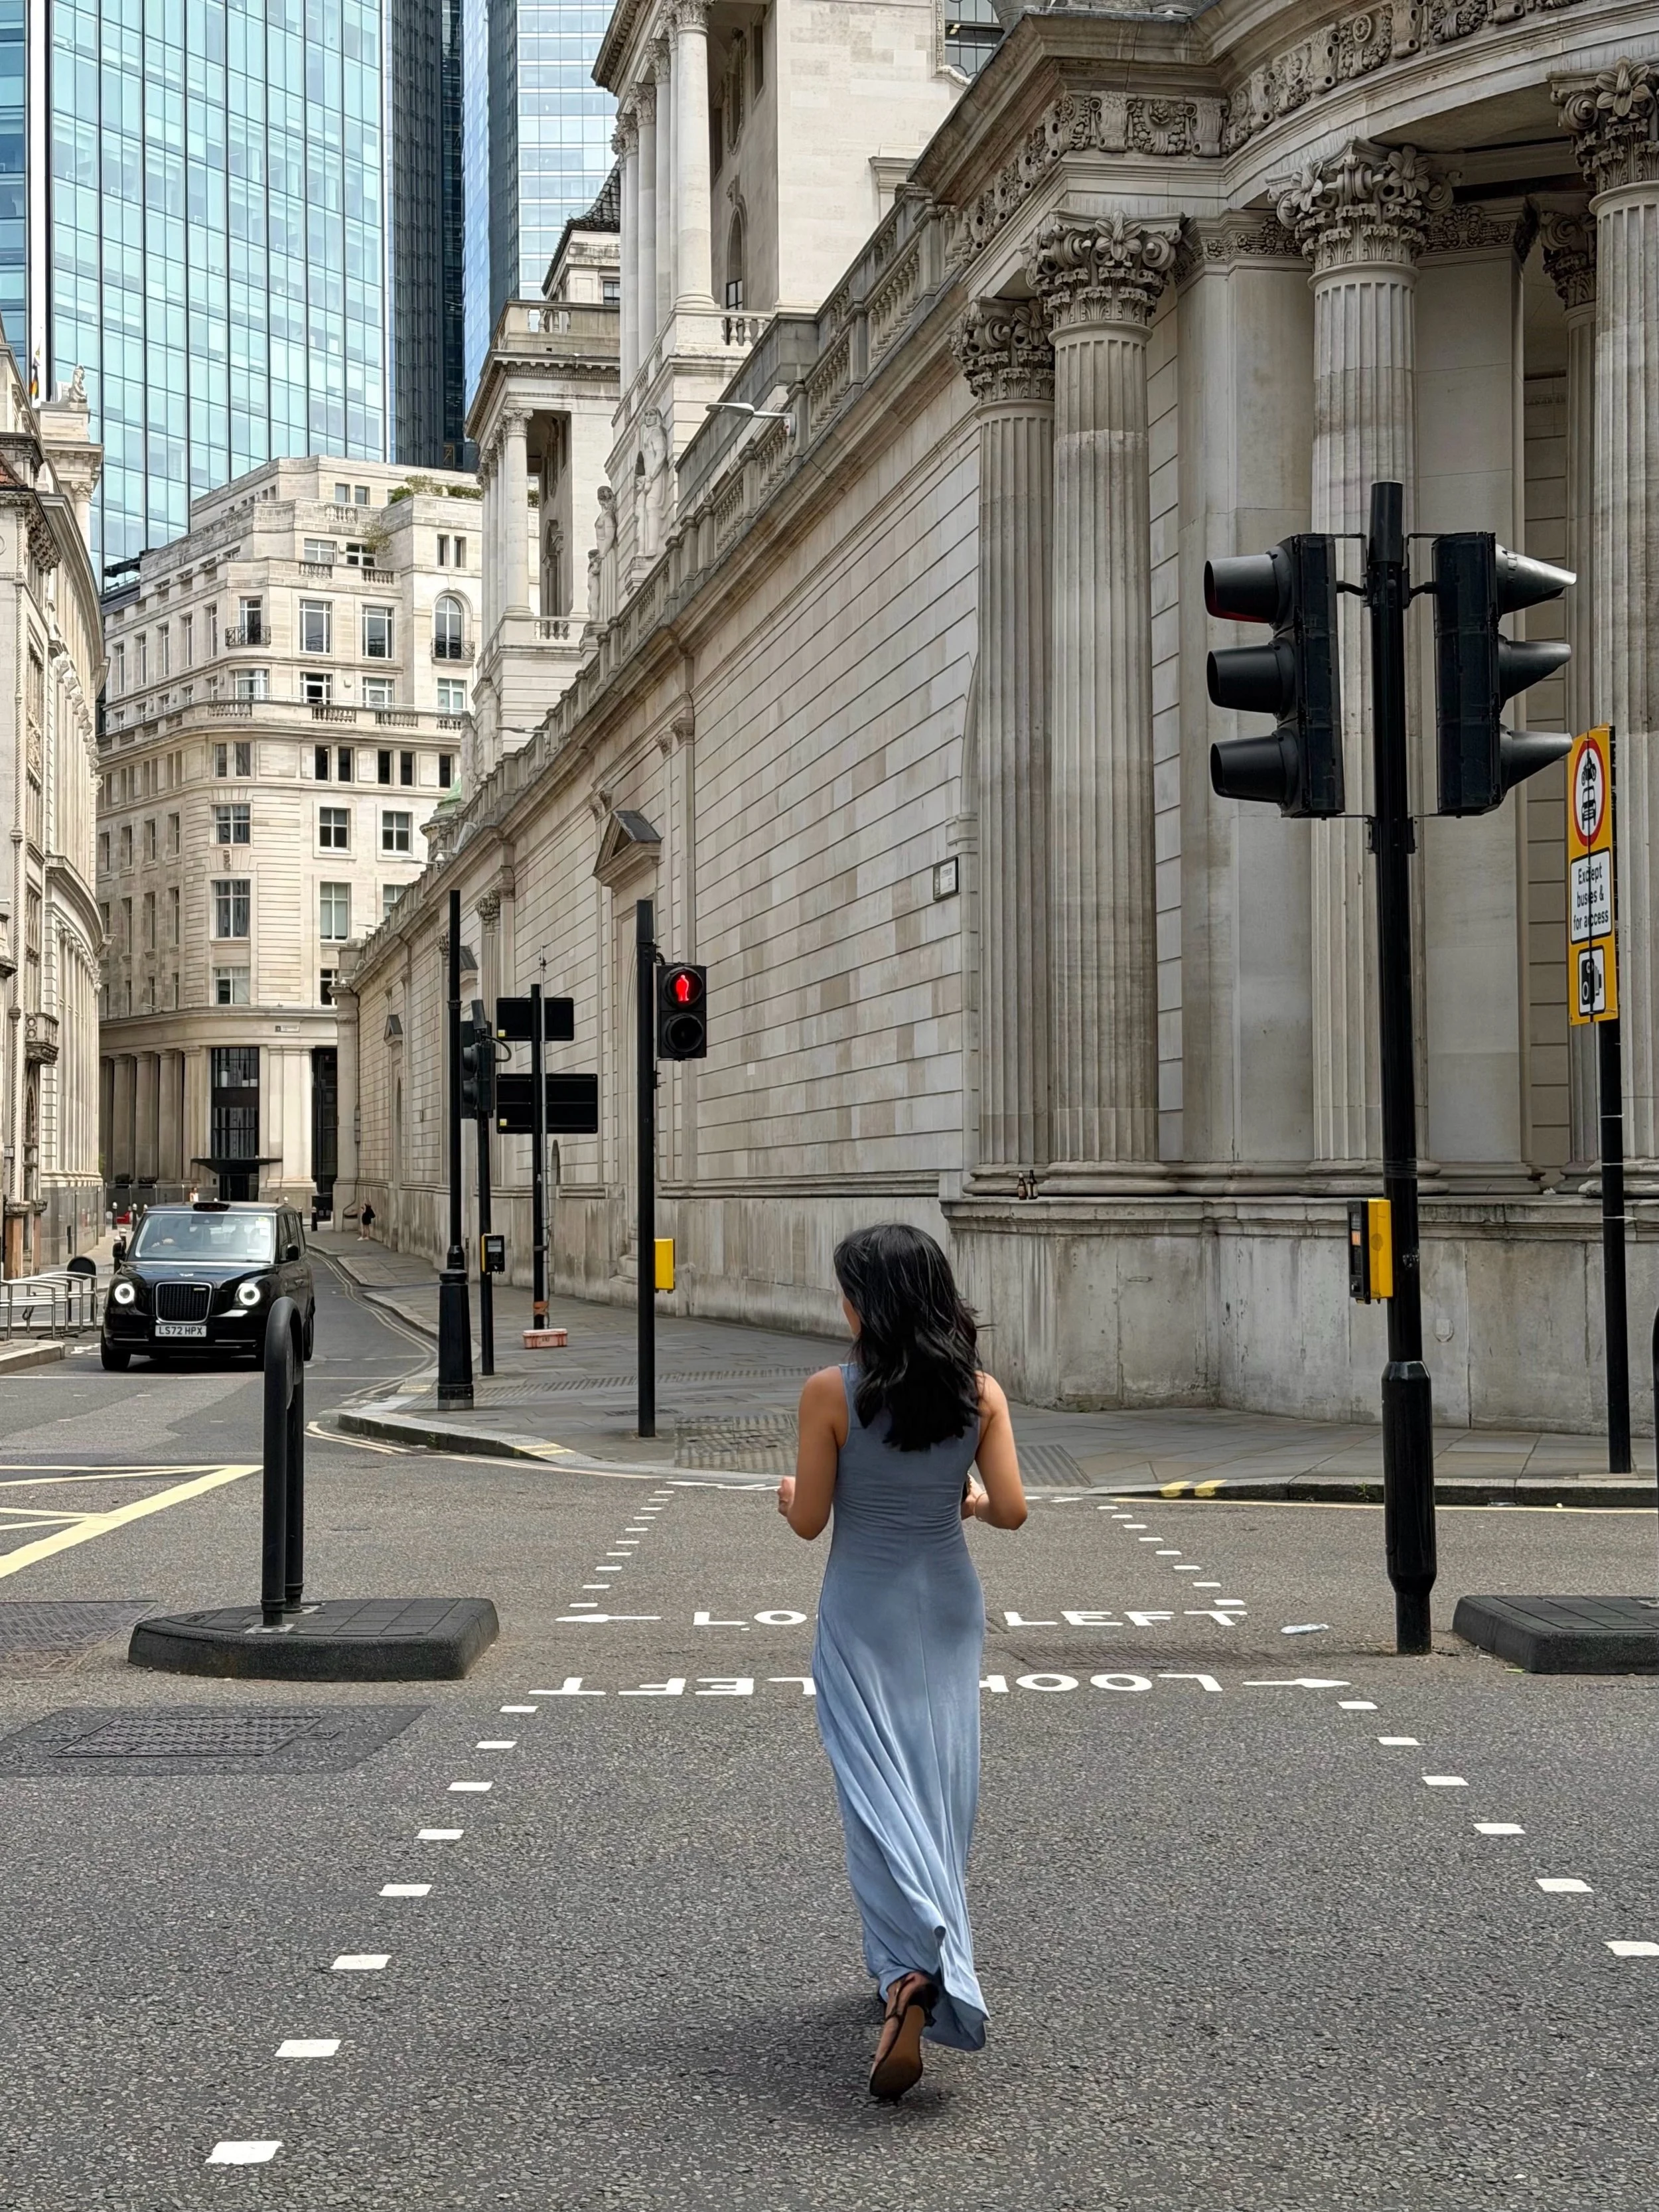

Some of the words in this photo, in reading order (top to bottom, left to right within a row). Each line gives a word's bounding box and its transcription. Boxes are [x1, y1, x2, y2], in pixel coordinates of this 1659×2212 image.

[1578, 862, 1603, 885] Except
[1577, 891, 1597, 908] buses
[1599, 885, 1604, 901] &
[1573, 915, 1582, 931] for
[693, 1611, 819, 1627] LO
[1004, 1611, 1248, 1626] LEFT
[529, 1678, 817, 1695] LEFT
